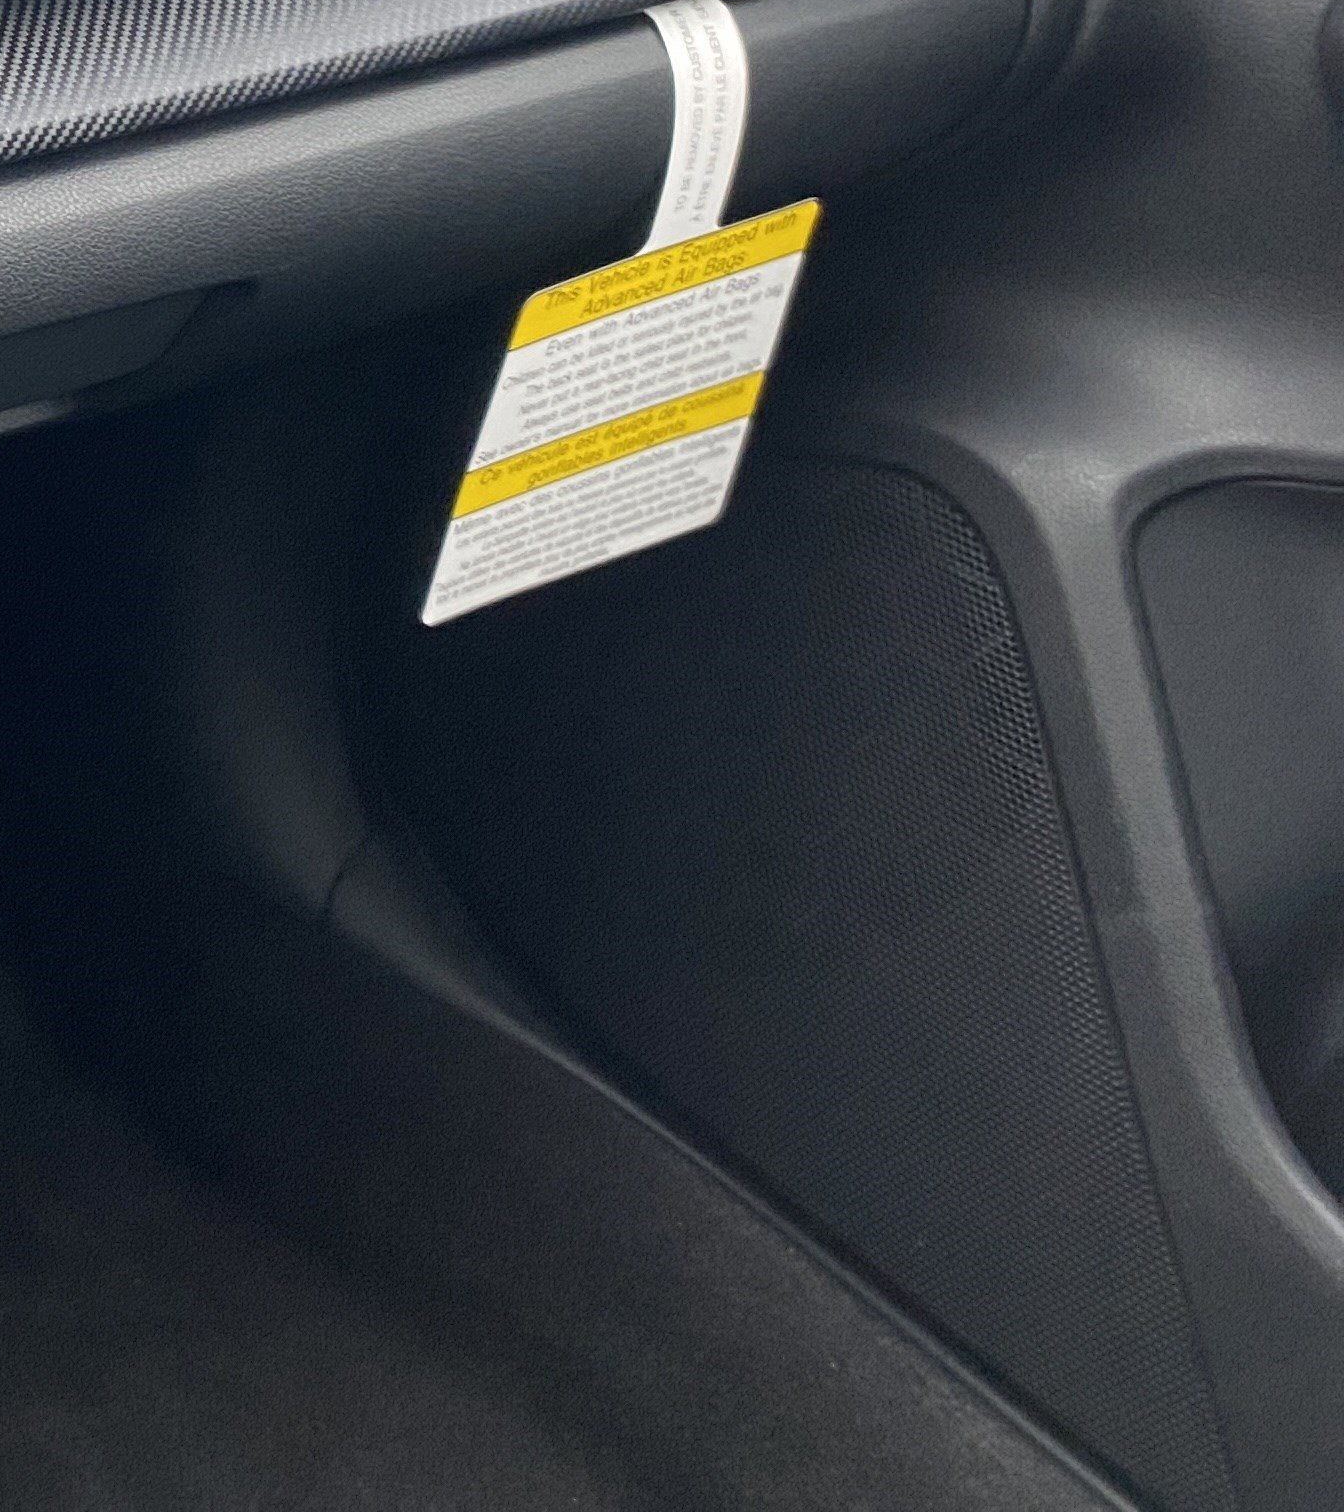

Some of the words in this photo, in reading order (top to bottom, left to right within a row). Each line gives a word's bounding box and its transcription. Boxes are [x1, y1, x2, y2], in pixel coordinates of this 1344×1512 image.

[544, 285, 580, 310] This
[589, 261, 651, 294] Vehicle
[658, 252, 673, 270] is
[678, 226, 759, 265] Equipped
[765, 211, 797, 235] with
[579, 277, 666, 318] Advanced
[672, 266, 698, 285] Air
[703, 251, 748, 275] Bags
[545, 332, 583, 357] Even
[589, 319, 618, 338] with
[623, 294, 695, 327] Advanced
[700, 284, 721, 301] Air
[725, 272, 762, 296] Bags
